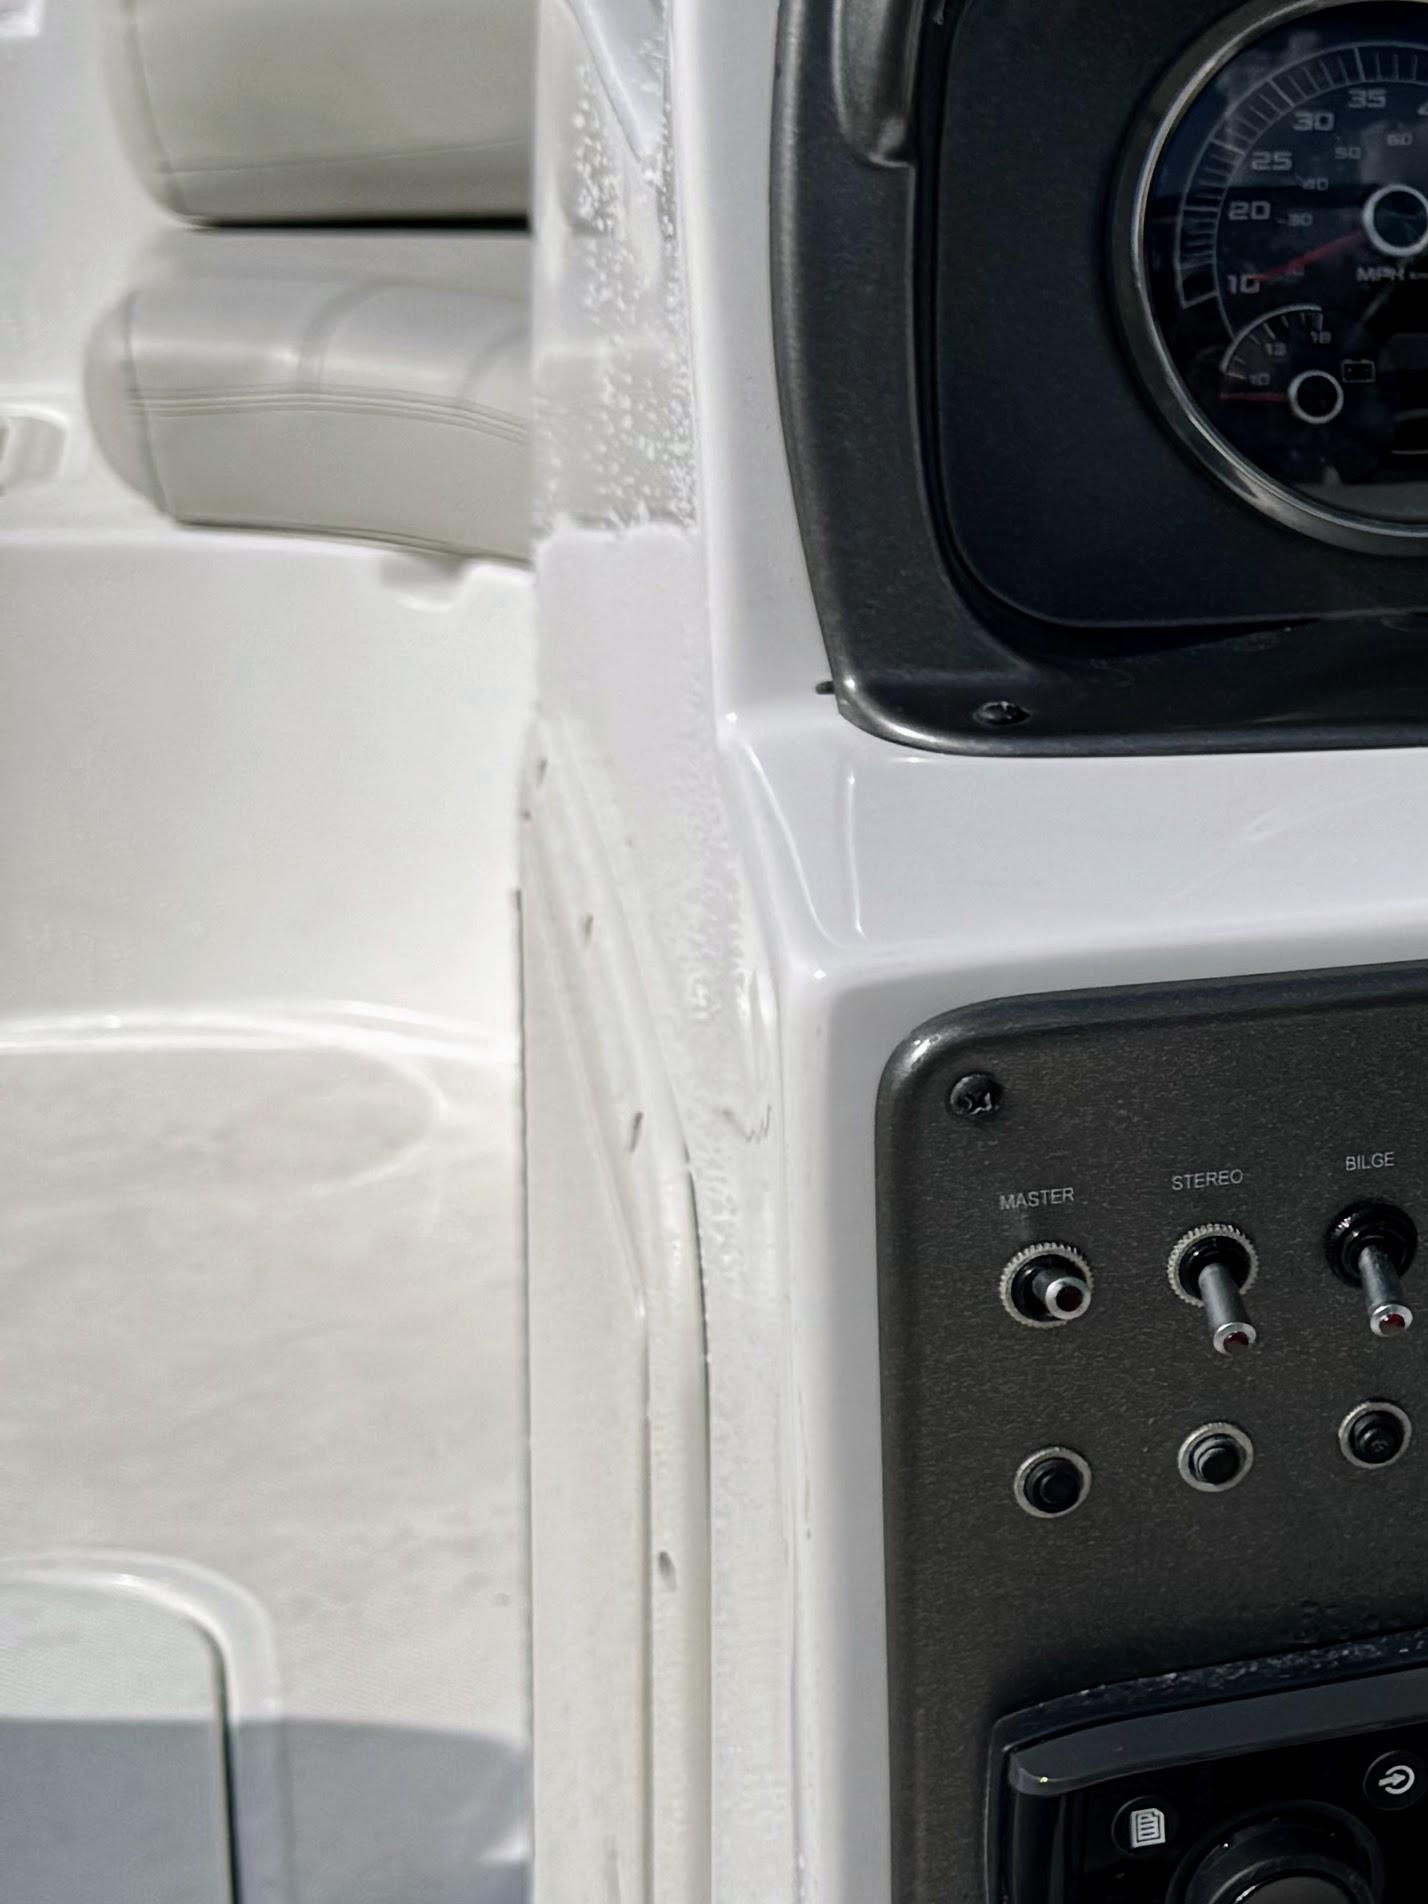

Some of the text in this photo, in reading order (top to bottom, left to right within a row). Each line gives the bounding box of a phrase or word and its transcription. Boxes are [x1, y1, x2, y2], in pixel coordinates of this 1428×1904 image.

[1348, 89, 1387, 109] 35
[1293, 112, 1334, 132] 30
[1251, 151, 1292, 171] 25
[1335, 147, 1362, 159] 50
[1228, 201, 1271, 221] 20
[1228, 274, 1260, 294] 10
[1355, 267, 1405, 282] MPH
[999, 1187, 1075, 1211] MASTER
[1171, 1168, 1244, 1191] STEREO
[1345, 1151, 1396, 1171] BILGE
